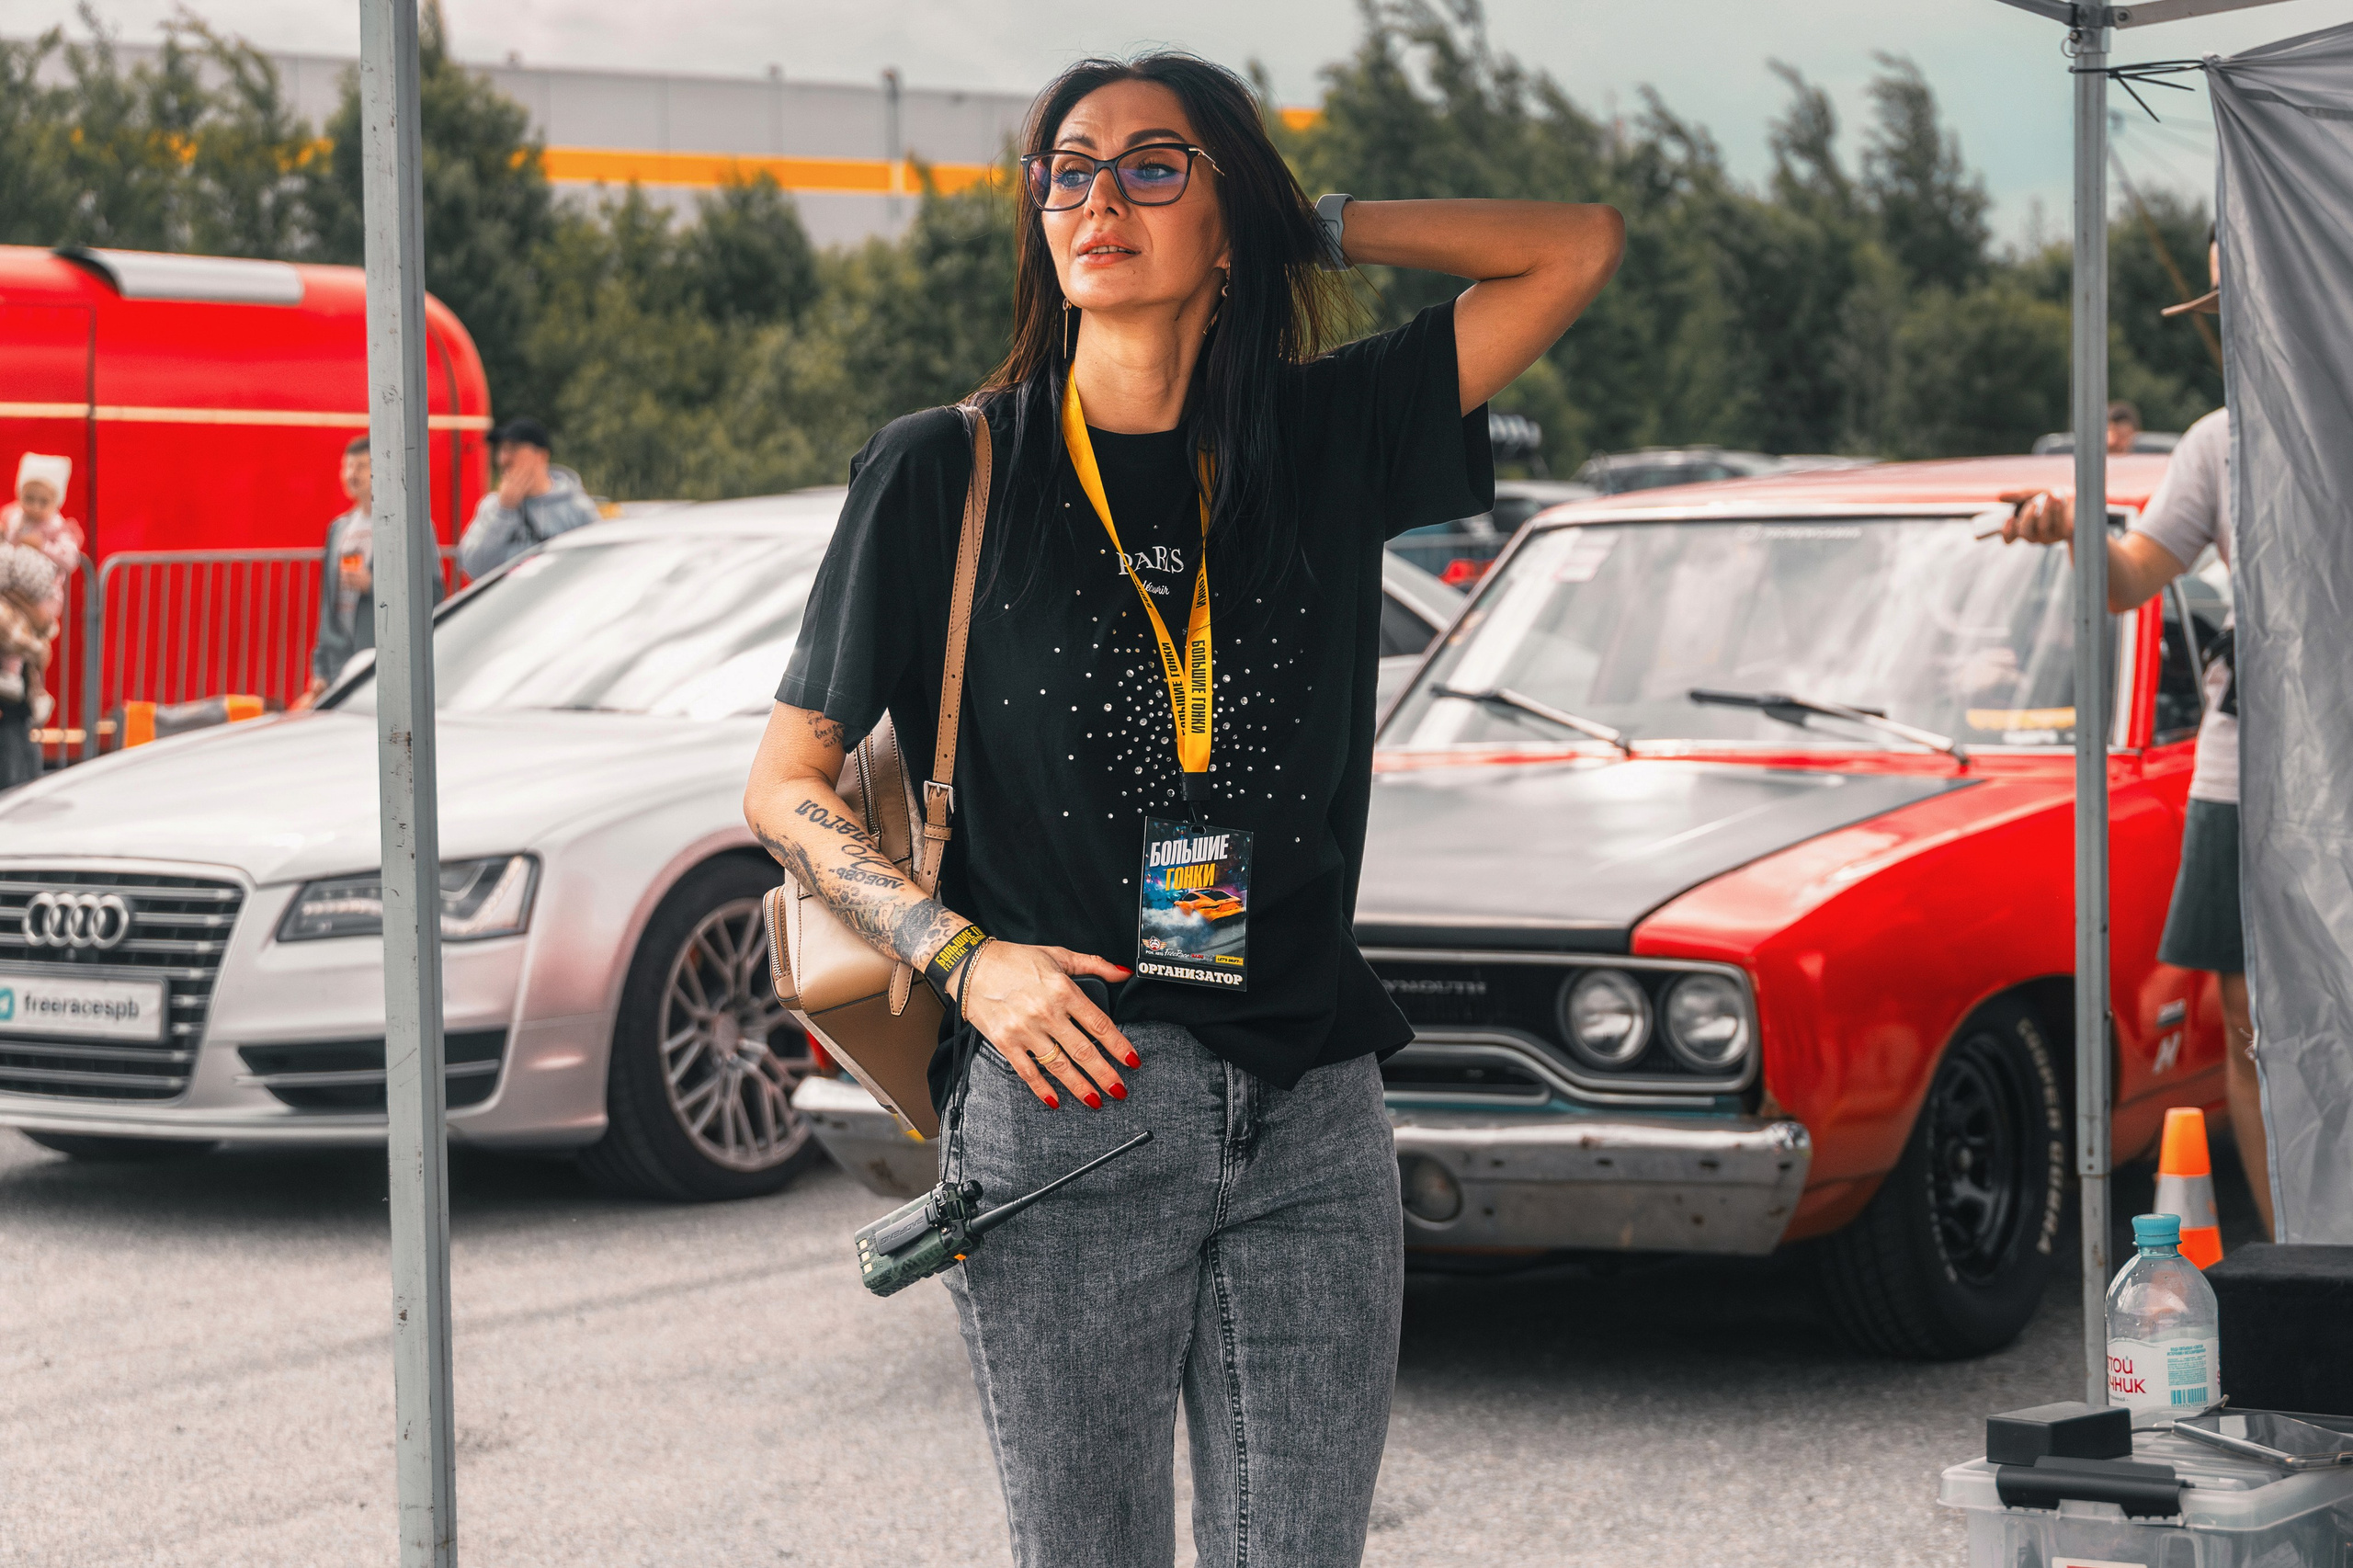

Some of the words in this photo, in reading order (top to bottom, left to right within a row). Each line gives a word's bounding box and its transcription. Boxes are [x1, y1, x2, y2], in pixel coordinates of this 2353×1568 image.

[1161, 642, 1181, 677] ГОНКИ
[1191, 640, 1205, 694] БОЛЬШИЕ
[1172, 680, 1185, 735] ЛЬШИЕ
[1191, 697, 1205, 733] ГОНКИ
[1150, 834, 1230, 867] БОЛЬШИЕ
[1165, 863, 1216, 891] ГОНКИ
[935, 928, 975, 968] БОЛЬШИЕ
[943, 947, 969, 971] FESTIVAL
[1138, 962, 1244, 985] ОРГАНИЗАТОР
[25, 990, 140, 1022] freeracespb
